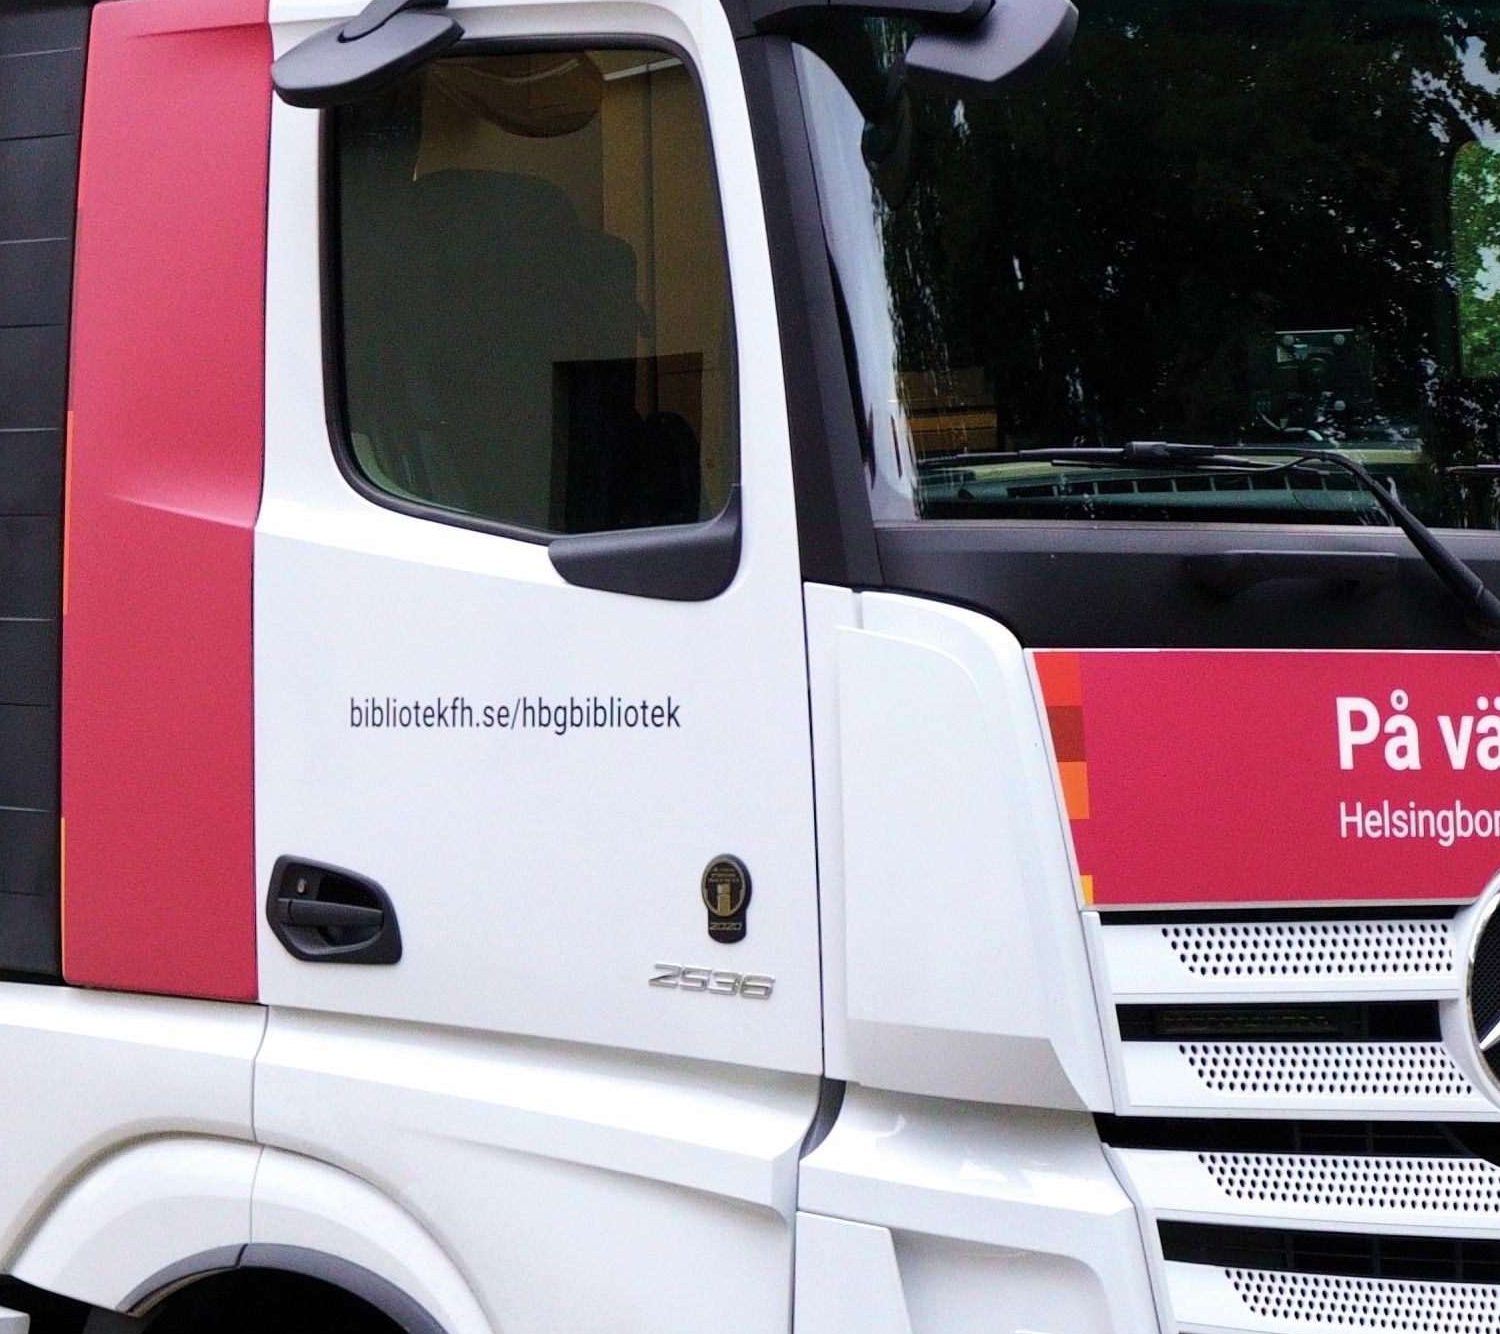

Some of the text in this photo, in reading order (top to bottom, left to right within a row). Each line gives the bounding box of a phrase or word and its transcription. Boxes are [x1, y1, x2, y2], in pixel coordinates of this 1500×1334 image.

[350, 696, 681, 736] bibliotekfh.se/hbgbibliotek
[1335, 689, 1422, 771] På
[648, 961, 776, 1000] 2536
